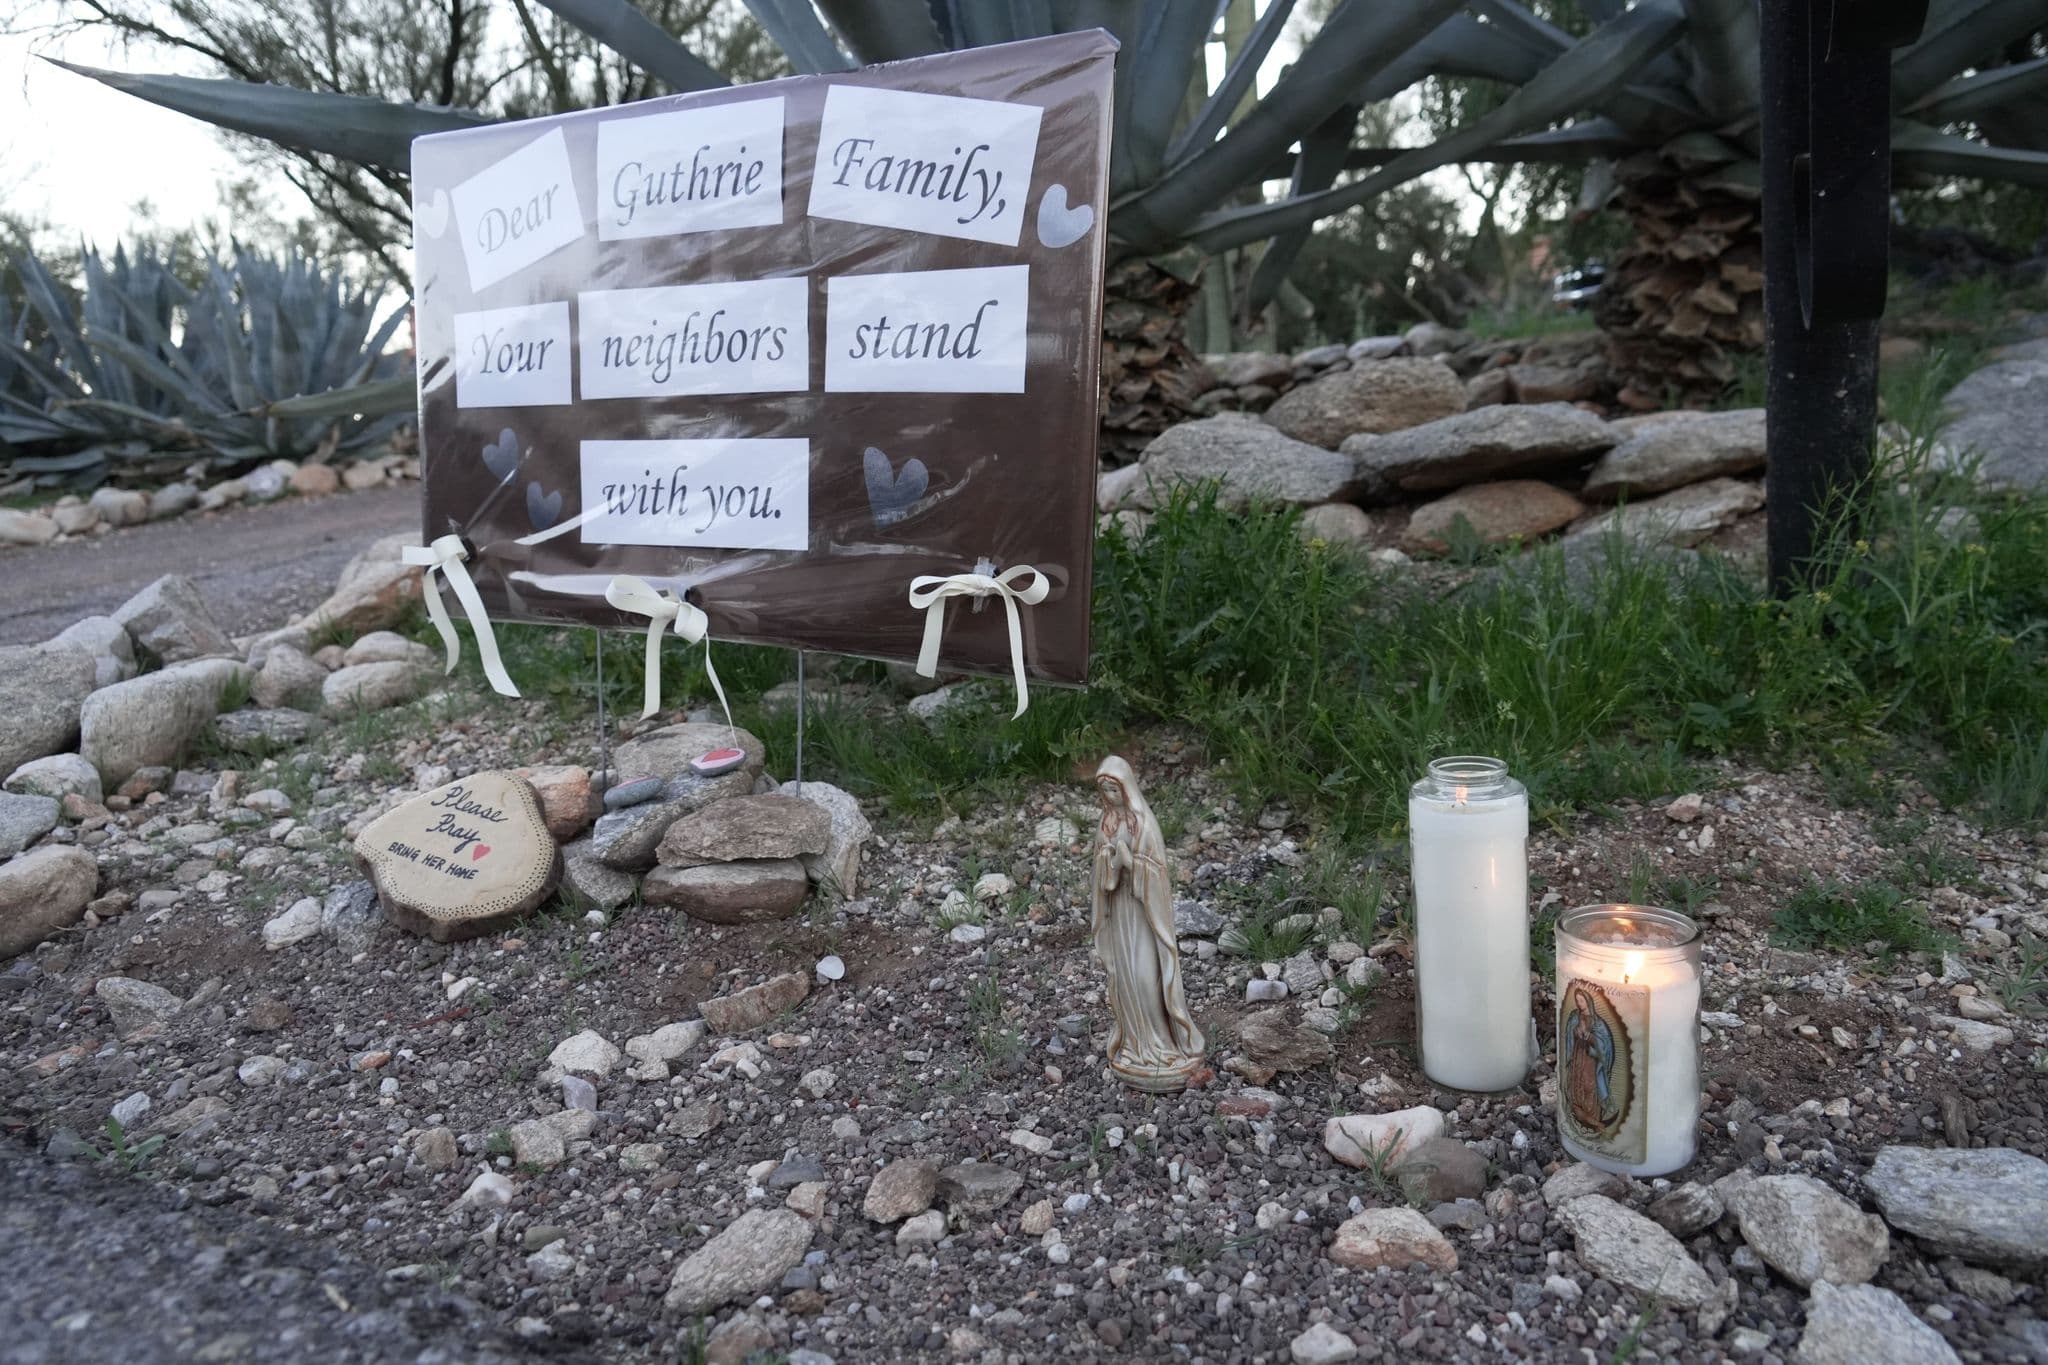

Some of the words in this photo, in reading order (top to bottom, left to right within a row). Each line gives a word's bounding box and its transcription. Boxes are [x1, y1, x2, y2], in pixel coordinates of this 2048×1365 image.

[477, 183, 559, 254] Dear
[612, 145, 764, 226] Guthrie
[832, 138, 1006, 224] Family,
[472, 328, 554, 374] Your
[602, 309, 788, 384] neighbors
[849, 300, 999, 359] stand
[602, 465, 688, 516] with
[695, 485, 781, 534] you.
[430, 785, 508, 823] Please
[388, 842, 421, 861] BRING
[422, 855, 446, 871] HER
[446, 864, 478, 879] HOME
[425, 813, 480, 854] Pray
